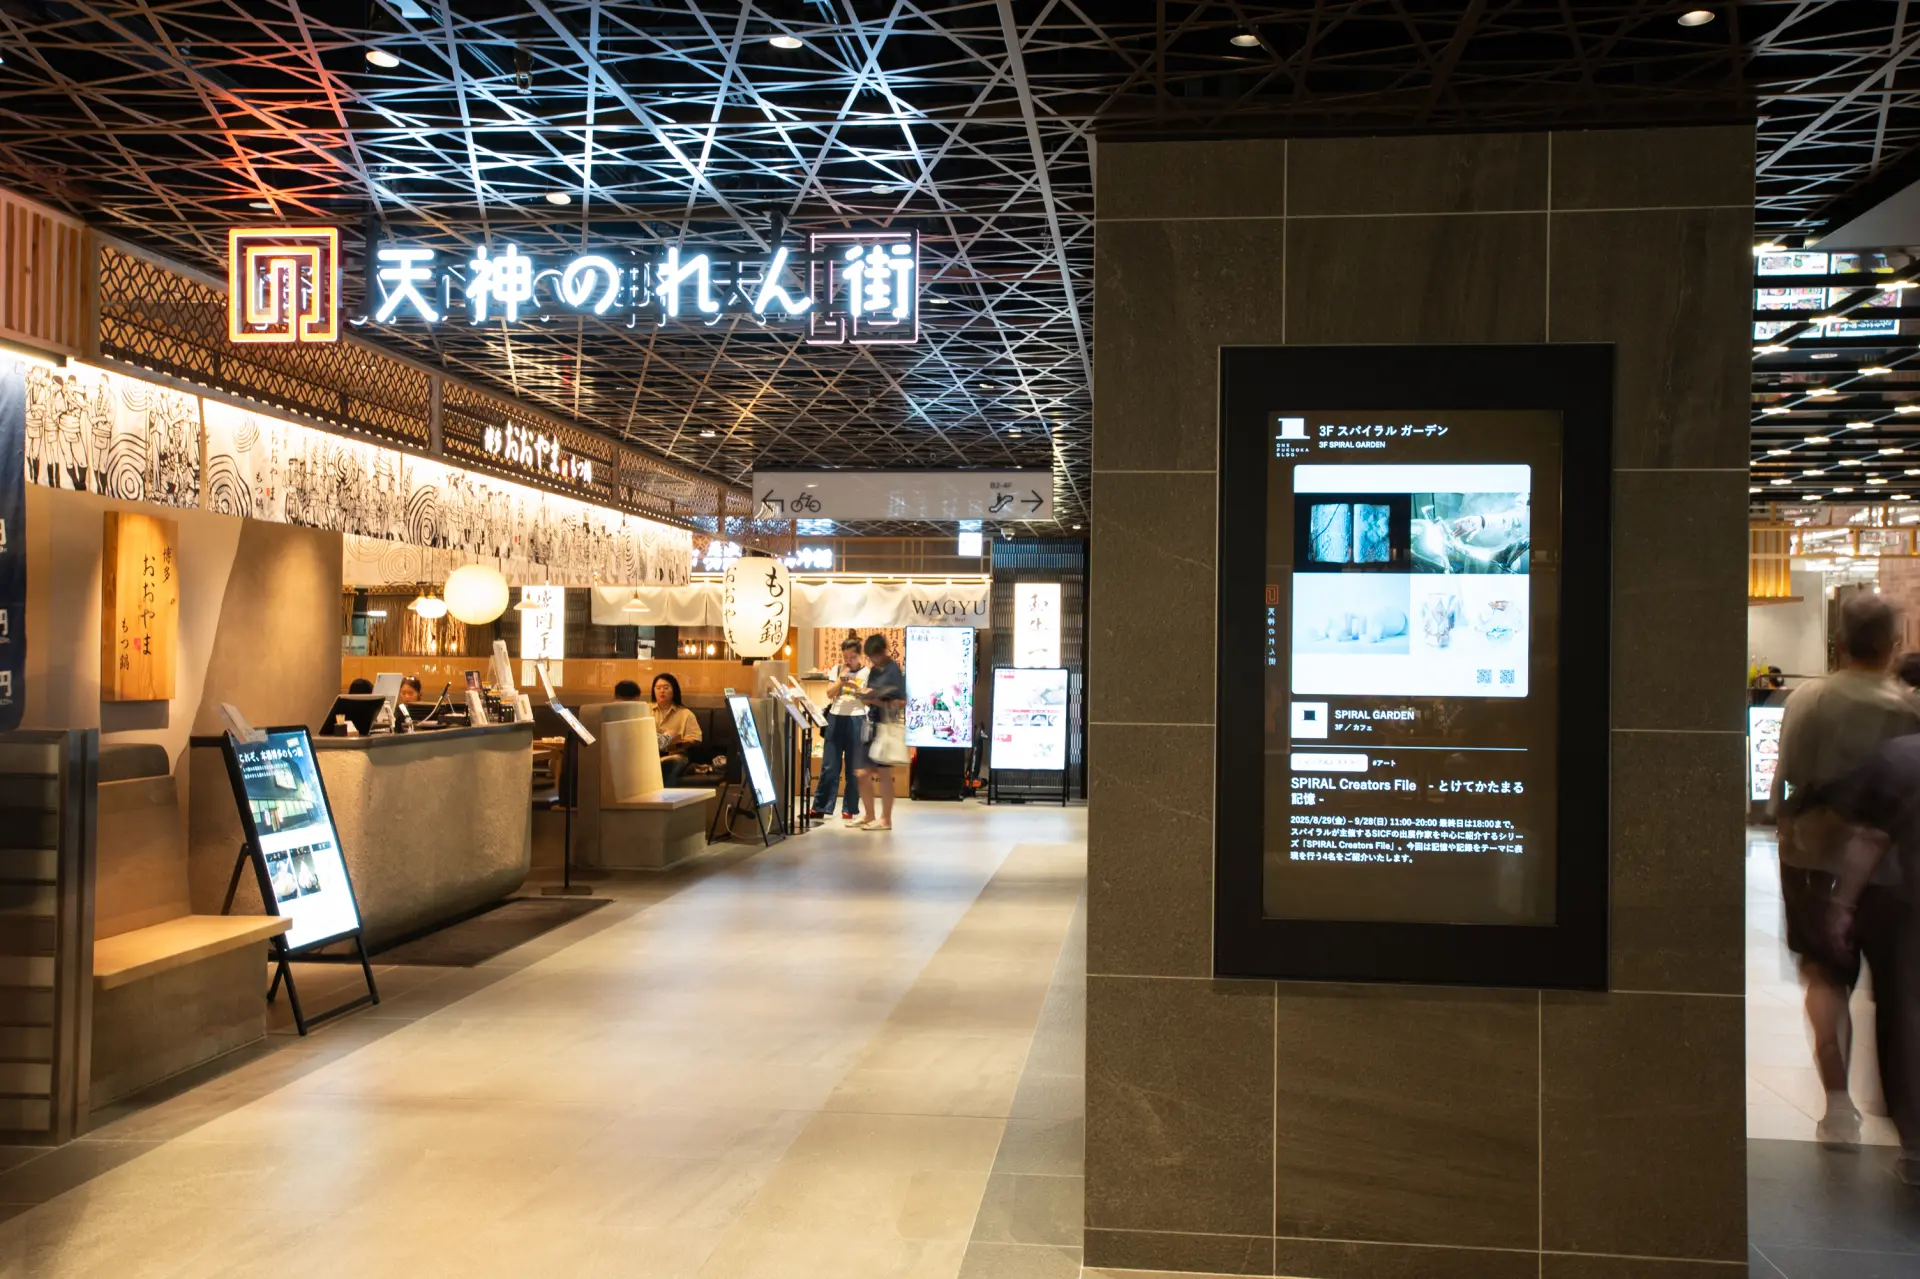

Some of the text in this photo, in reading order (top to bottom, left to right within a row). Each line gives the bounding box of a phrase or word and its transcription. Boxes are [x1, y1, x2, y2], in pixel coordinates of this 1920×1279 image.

[375, 243, 914, 323] 天神のれん街
[1319, 424, 1448, 437] 3F スパイラル ガーデン
[1319, 441, 1386, 449] 3F SPIRAL GARDEN
[162, 547, 172, 584] 博多
[140, 552, 156, 656] おおやま
[759, 566, 784, 646] もつ鍋
[911, 599, 987, 616] WAGYU
[119, 616, 130, 671] もつ鍋
[1334, 710, 1415, 720] SPIRAL GARDEN
[1291, 777, 1336, 790] SPIRAL
[1339, 778, 1391, 790] Creators
[1394, 779, 1417, 791] File
[1439, 780, 1524, 793] とけてかたまる
[1291, 792, 1316, 805] 記憶
[1290, 816, 1346, 826] 2025/8/29(金)
[1354, 817, 1388, 827] 9/28(日)
[1339, 841, 1373, 850] Creators
